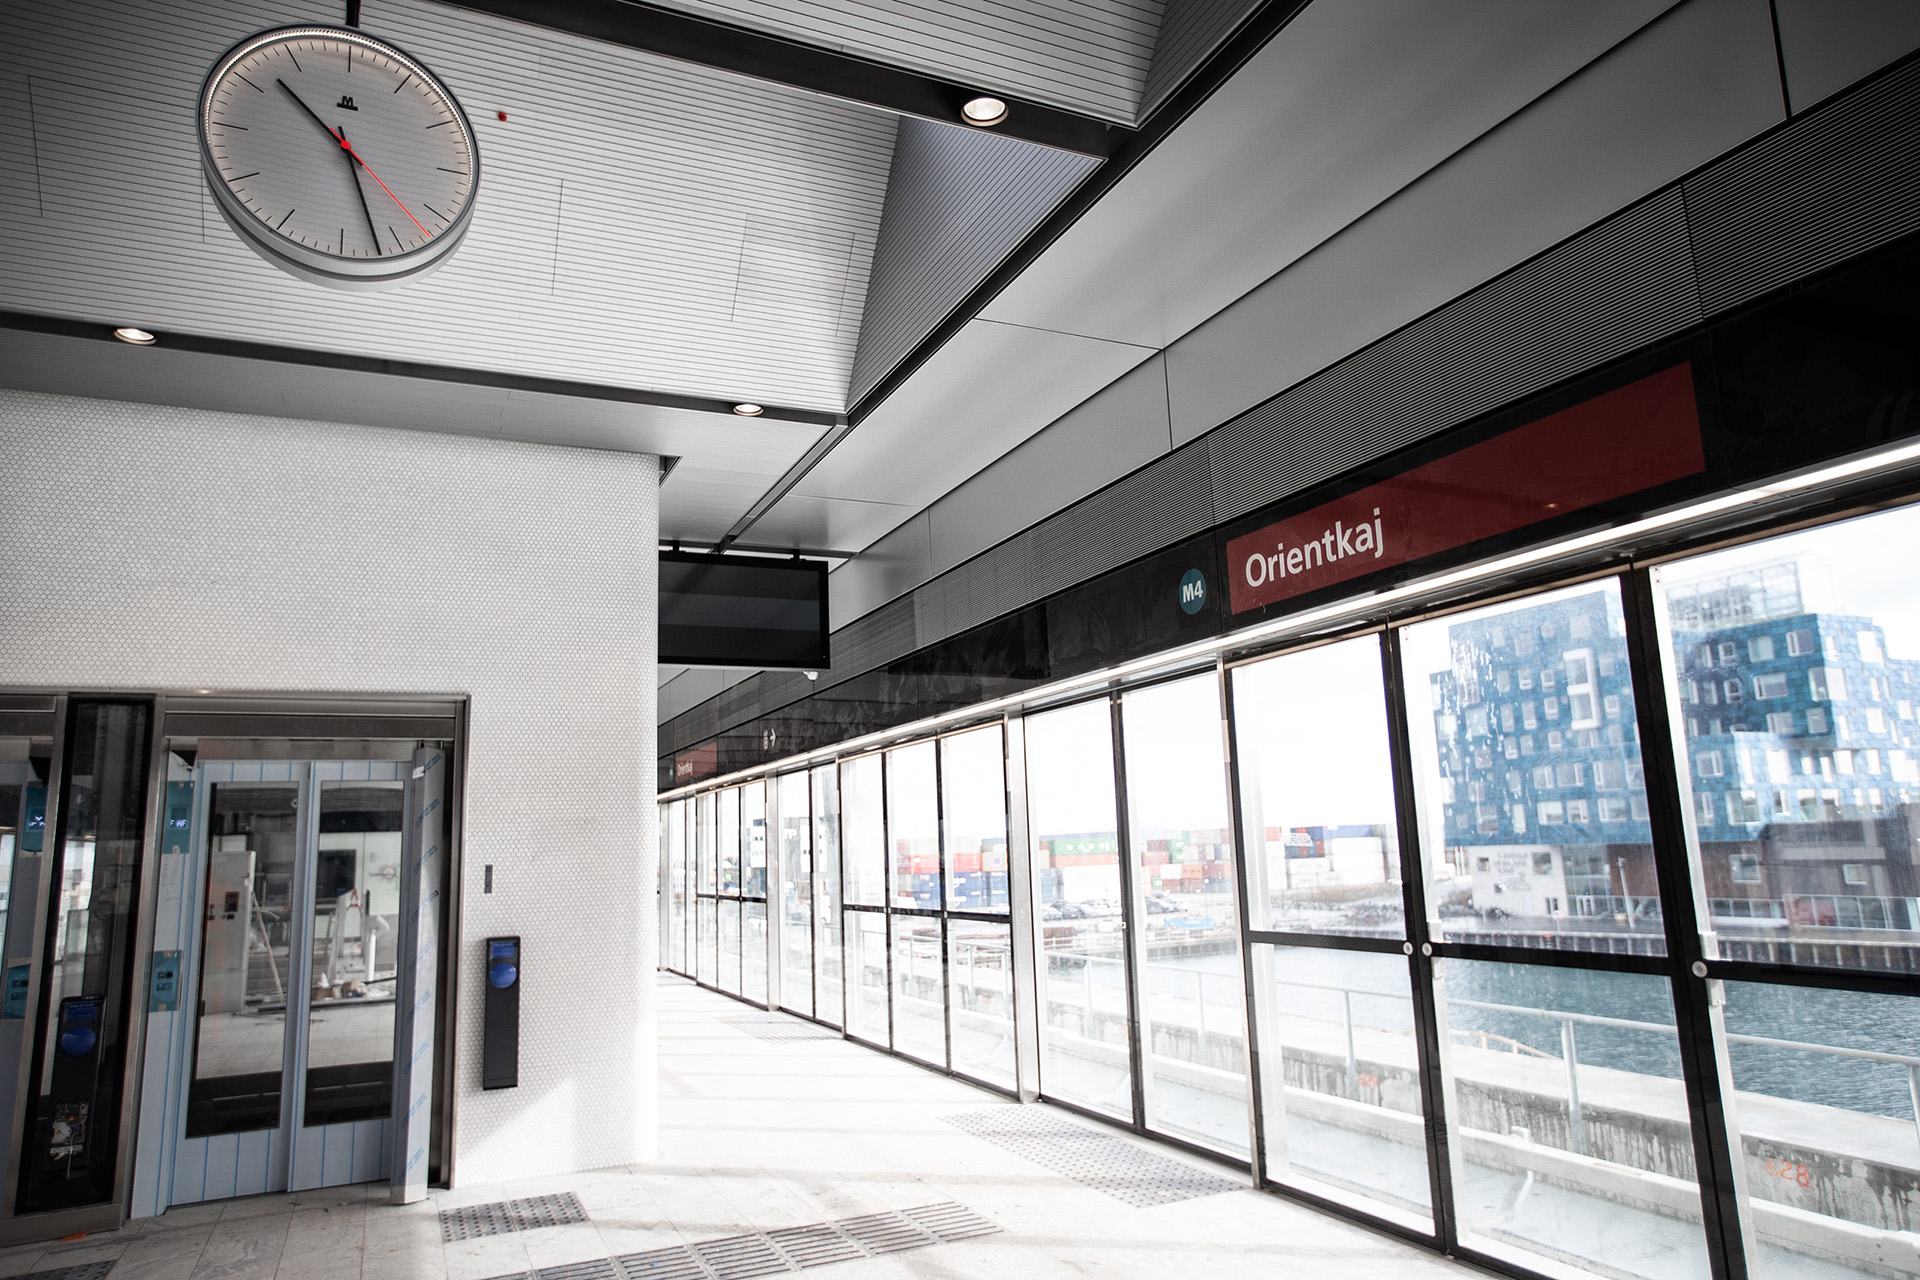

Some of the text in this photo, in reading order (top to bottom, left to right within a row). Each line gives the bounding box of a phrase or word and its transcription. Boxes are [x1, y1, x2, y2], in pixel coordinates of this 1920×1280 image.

[1245, 507, 1384, 588] Orientkaj
[1182, 580, 1204, 603] M4
[1765, 1158, 1810, 1189] 628
